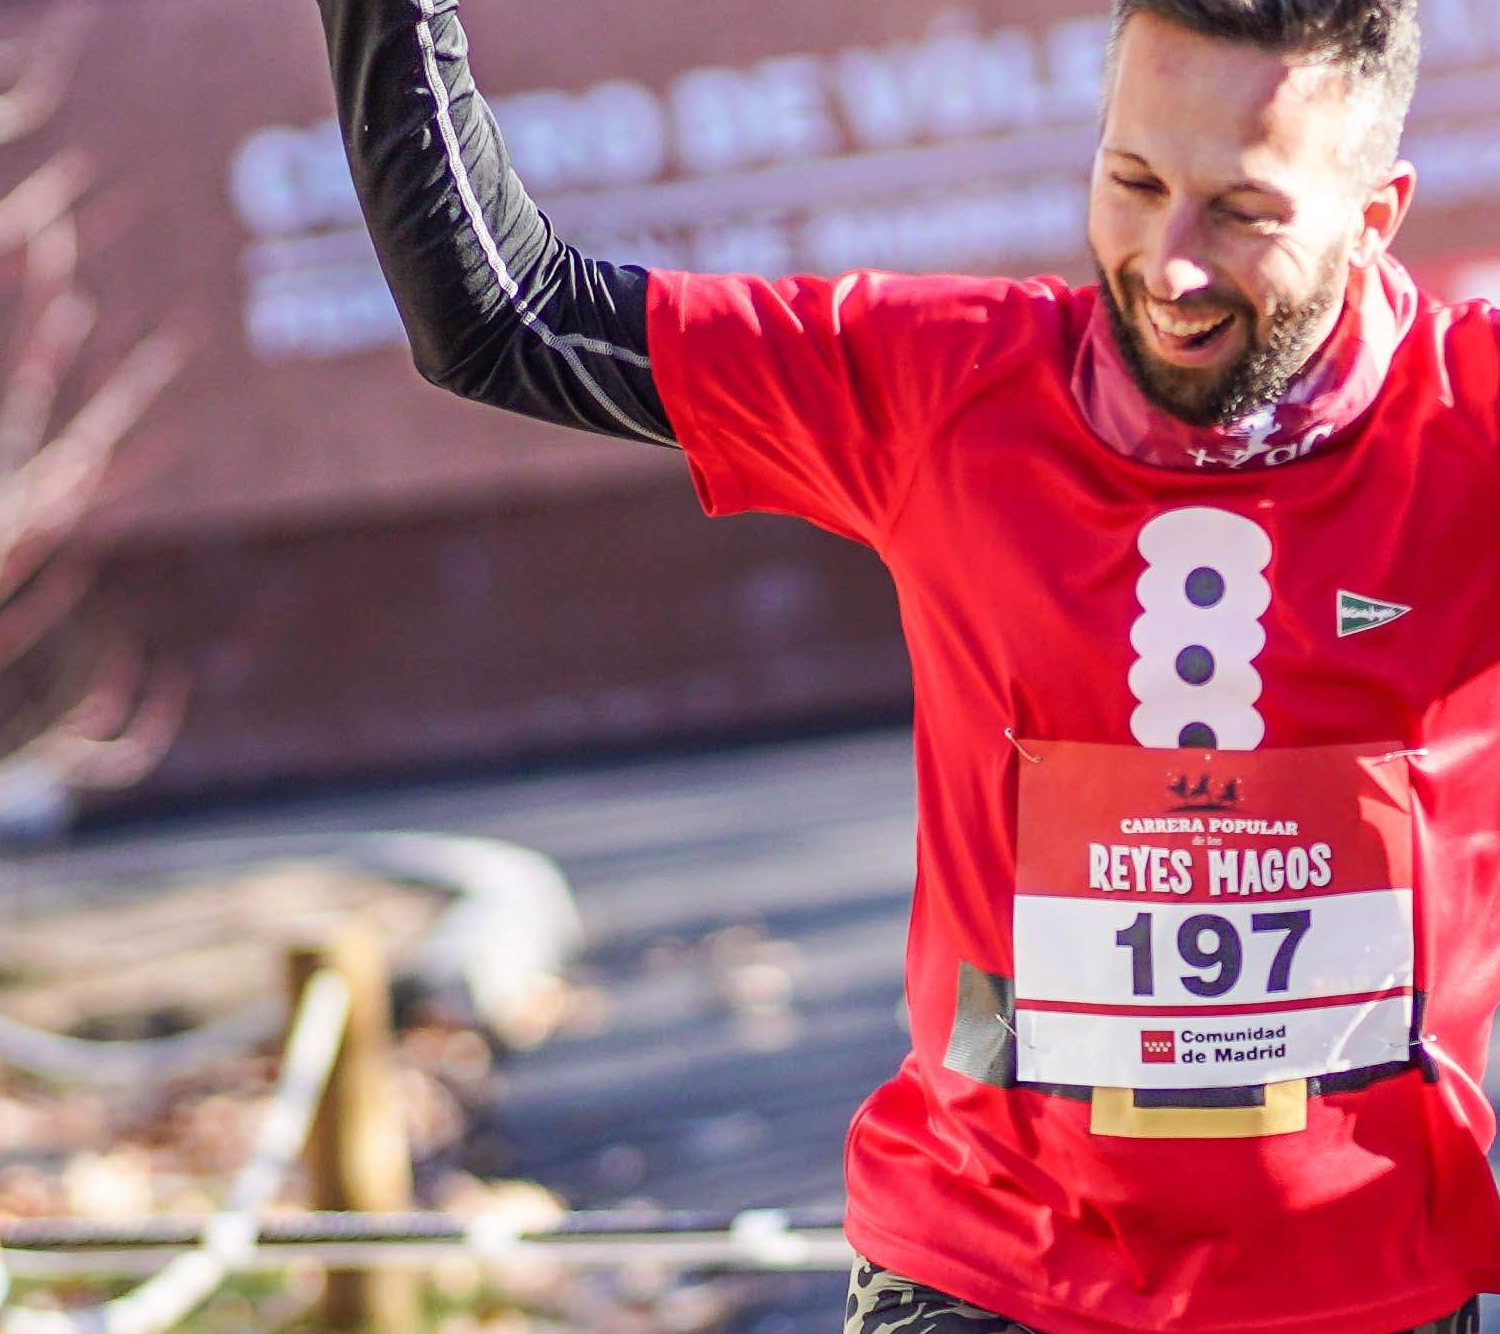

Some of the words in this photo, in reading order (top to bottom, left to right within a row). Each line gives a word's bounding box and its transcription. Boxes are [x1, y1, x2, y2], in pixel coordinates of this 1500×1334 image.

[1120, 818, 1205, 835] CARRERA
[1209, 818, 1299, 836] POPULAR
[1089, 843, 1193, 895] REYES
[1208, 843, 1332, 896] MAGOS
[1116, 909, 1311, 998] 197
[1181, 1025, 1286, 1043] Comunidad
[1181, 1049, 1207, 1063] de
[1215, 1044, 1286, 1062] Madrid
